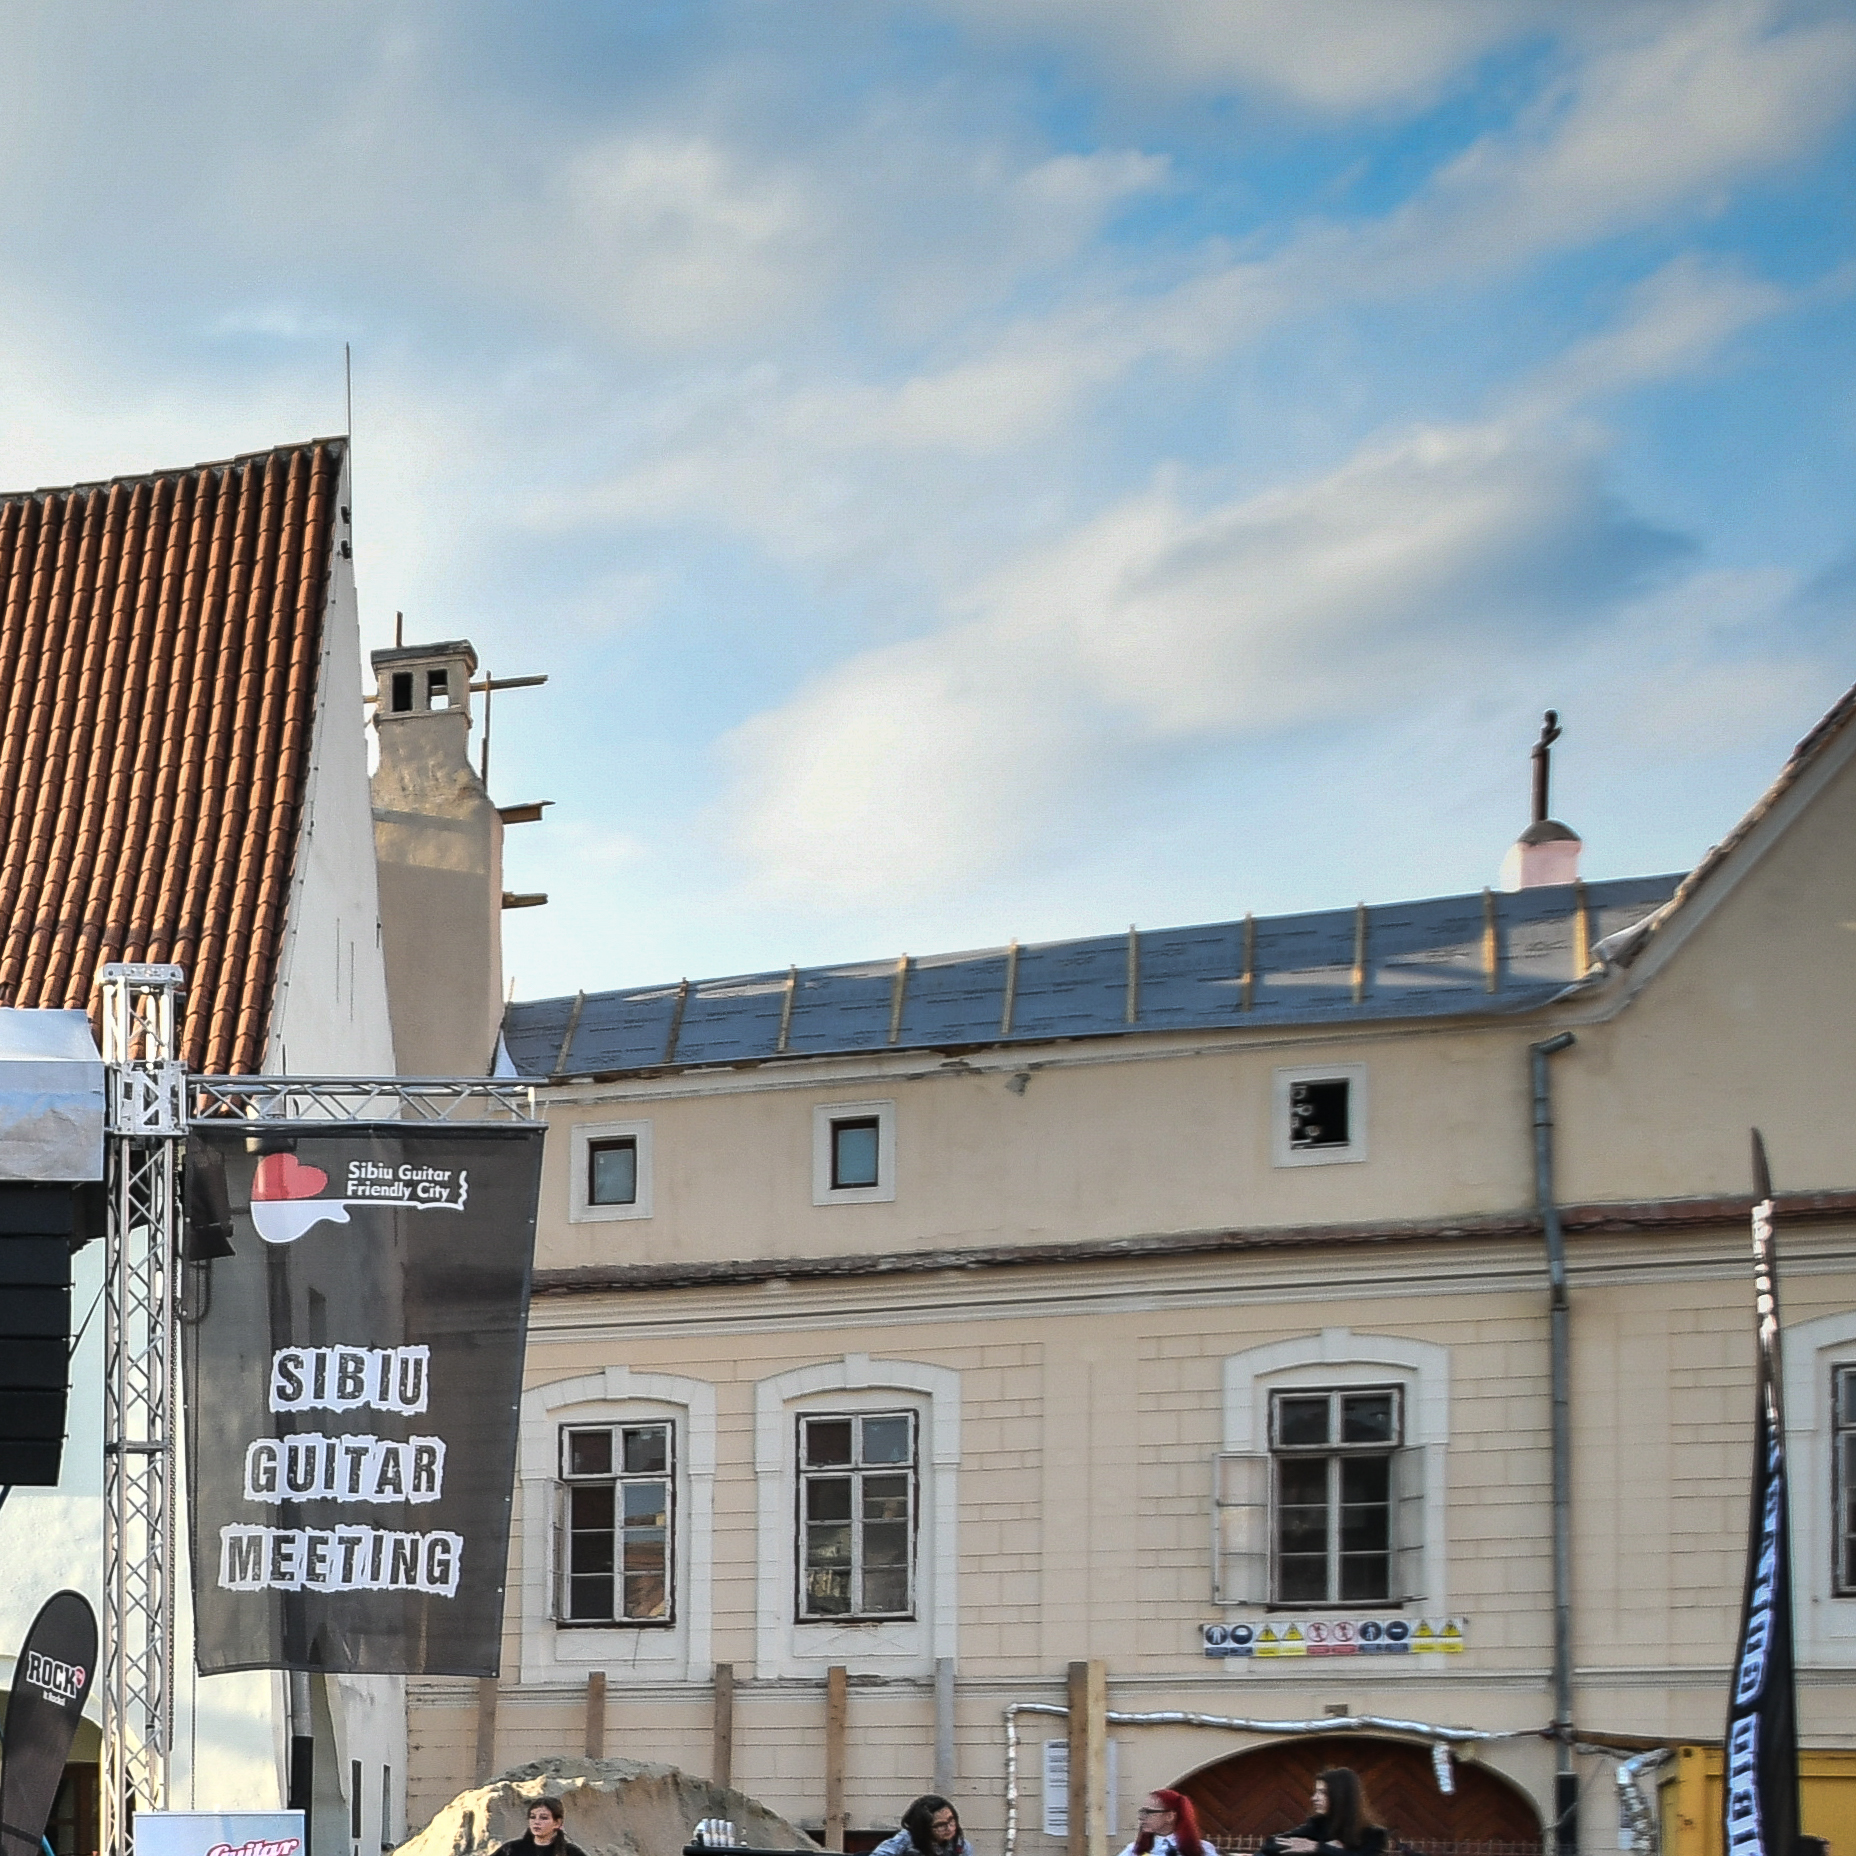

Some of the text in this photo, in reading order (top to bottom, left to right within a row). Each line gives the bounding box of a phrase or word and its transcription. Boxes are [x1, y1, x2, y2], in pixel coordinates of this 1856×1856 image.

[346, 1179, 451, 1203] Friendly City
[347, 1161, 452, 1182] Sibiu Guitar
[274, 1350, 424, 1408] SIBIU
[249, 1442, 440, 1496] GUITAR
[226, 1532, 455, 1587] MEETING
[26, 1650, 76, 1699] ROCK
